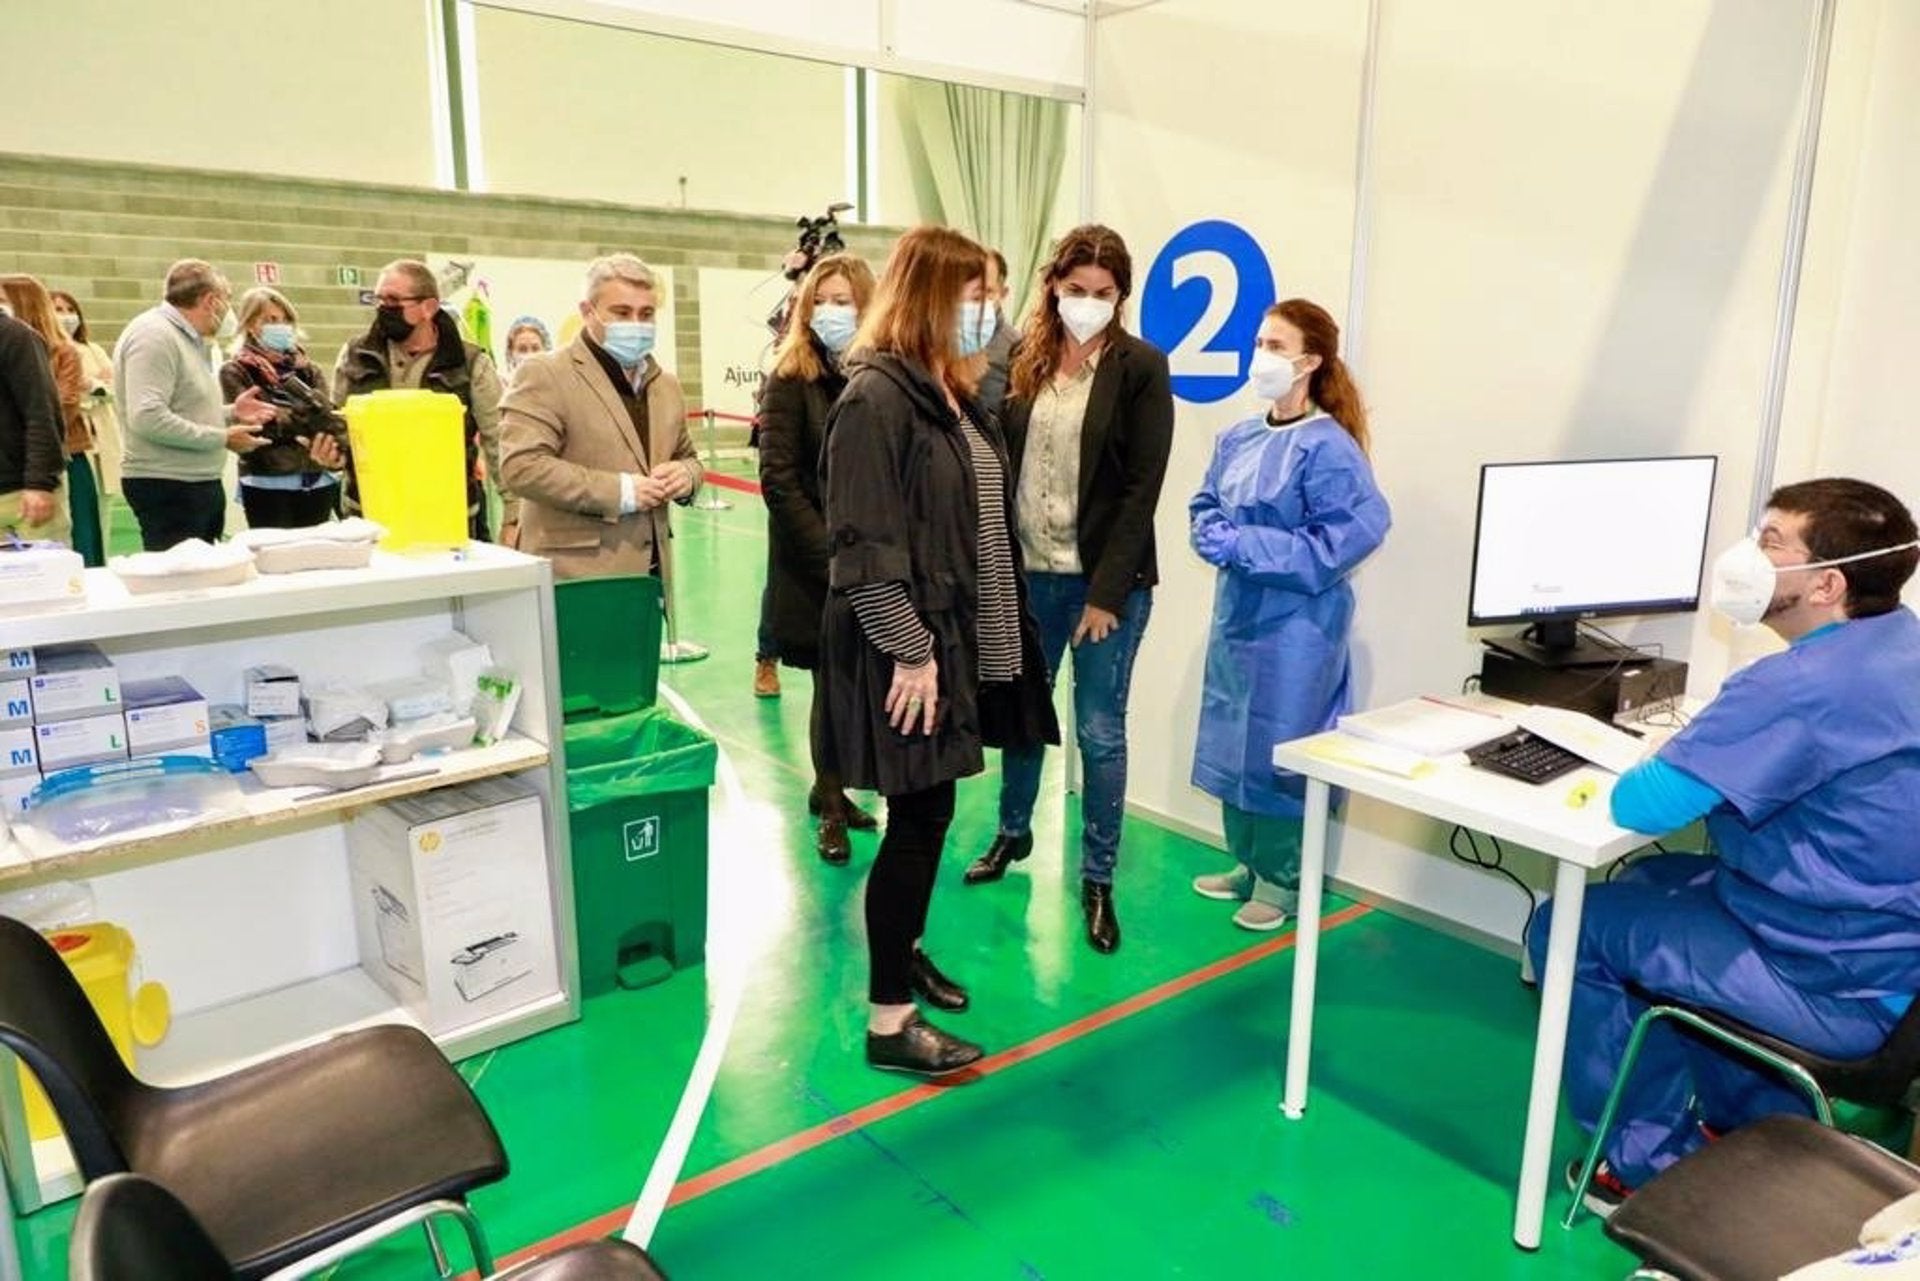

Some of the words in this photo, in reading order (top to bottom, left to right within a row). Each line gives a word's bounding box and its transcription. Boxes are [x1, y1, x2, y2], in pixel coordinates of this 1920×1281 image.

[1168, 249, 1240, 377] 2
[68, 575, 83, 593] S
[10, 651, 30, 668] M
[105, 687, 117, 702] L
[8, 701, 28, 717] M
[195, 719, 206, 734] S
[111, 734, 123, 748] L
[11, 749, 31, 766] M
